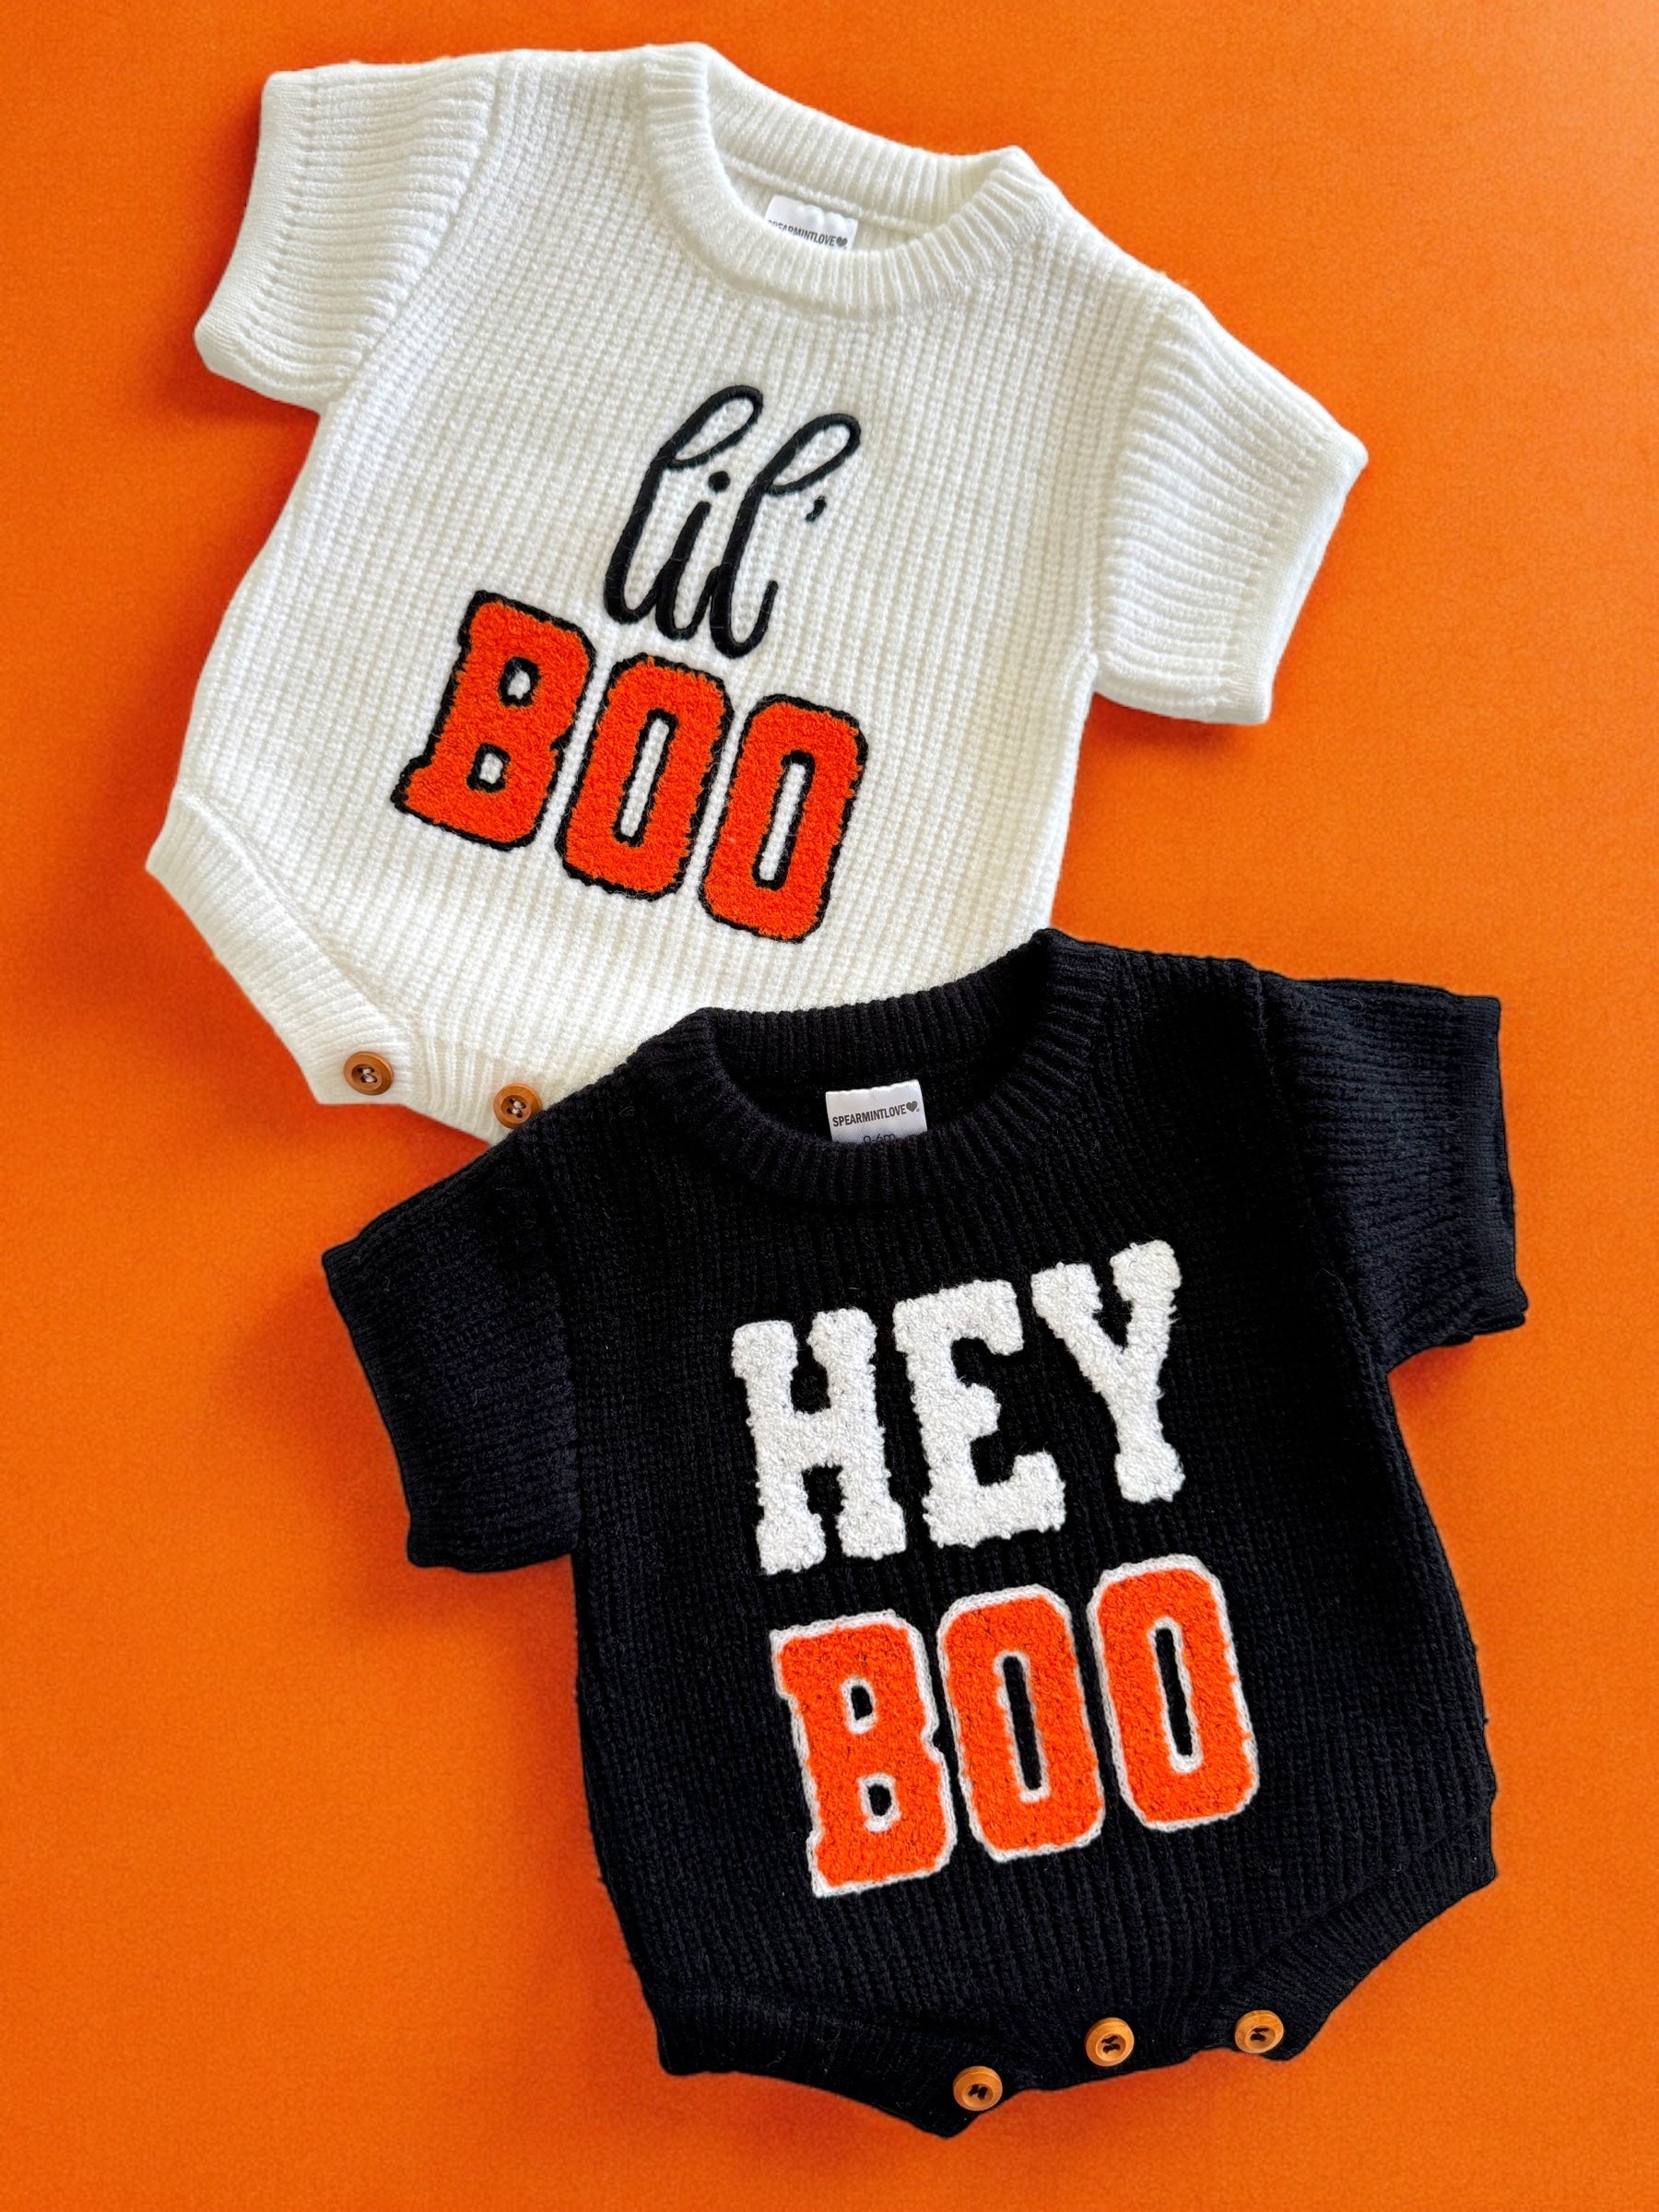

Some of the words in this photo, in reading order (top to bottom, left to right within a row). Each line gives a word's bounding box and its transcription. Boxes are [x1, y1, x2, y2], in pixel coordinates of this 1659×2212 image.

[604, 384, 861, 658] lil'
[390, 589, 868, 944] BOO
[832, 1104, 906, 1127] SPEARMINTLOVE
[732, 1240, 1185, 1575] HEY
[770, 1554, 1260, 1898] BOO
